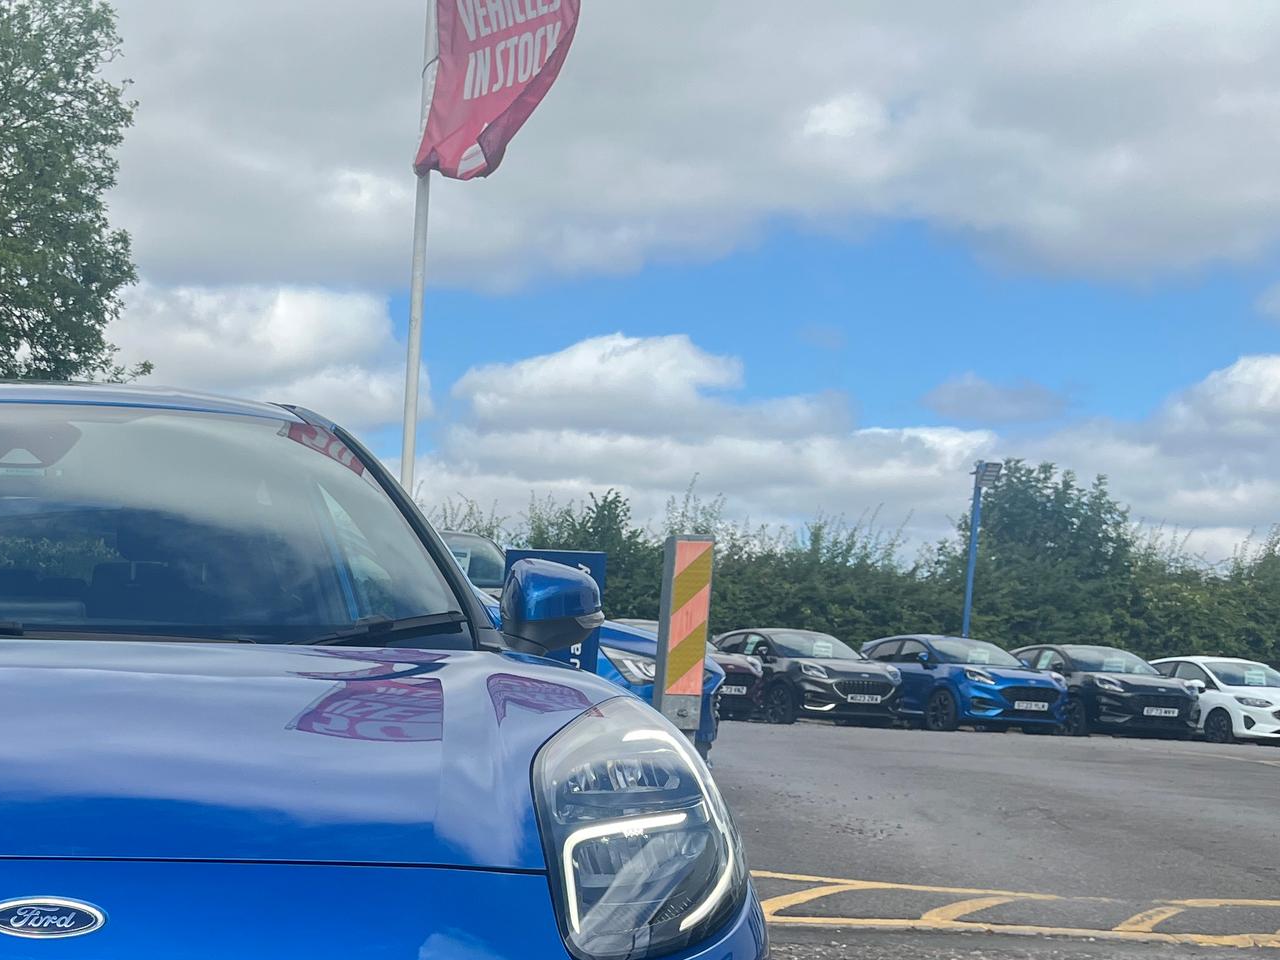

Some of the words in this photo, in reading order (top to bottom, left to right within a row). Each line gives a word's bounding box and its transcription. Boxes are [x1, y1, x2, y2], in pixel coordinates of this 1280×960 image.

[463, 46, 490, 100] IN
[492, 21, 561, 93] STOCK
[10, 906, 76, 928] Ford
